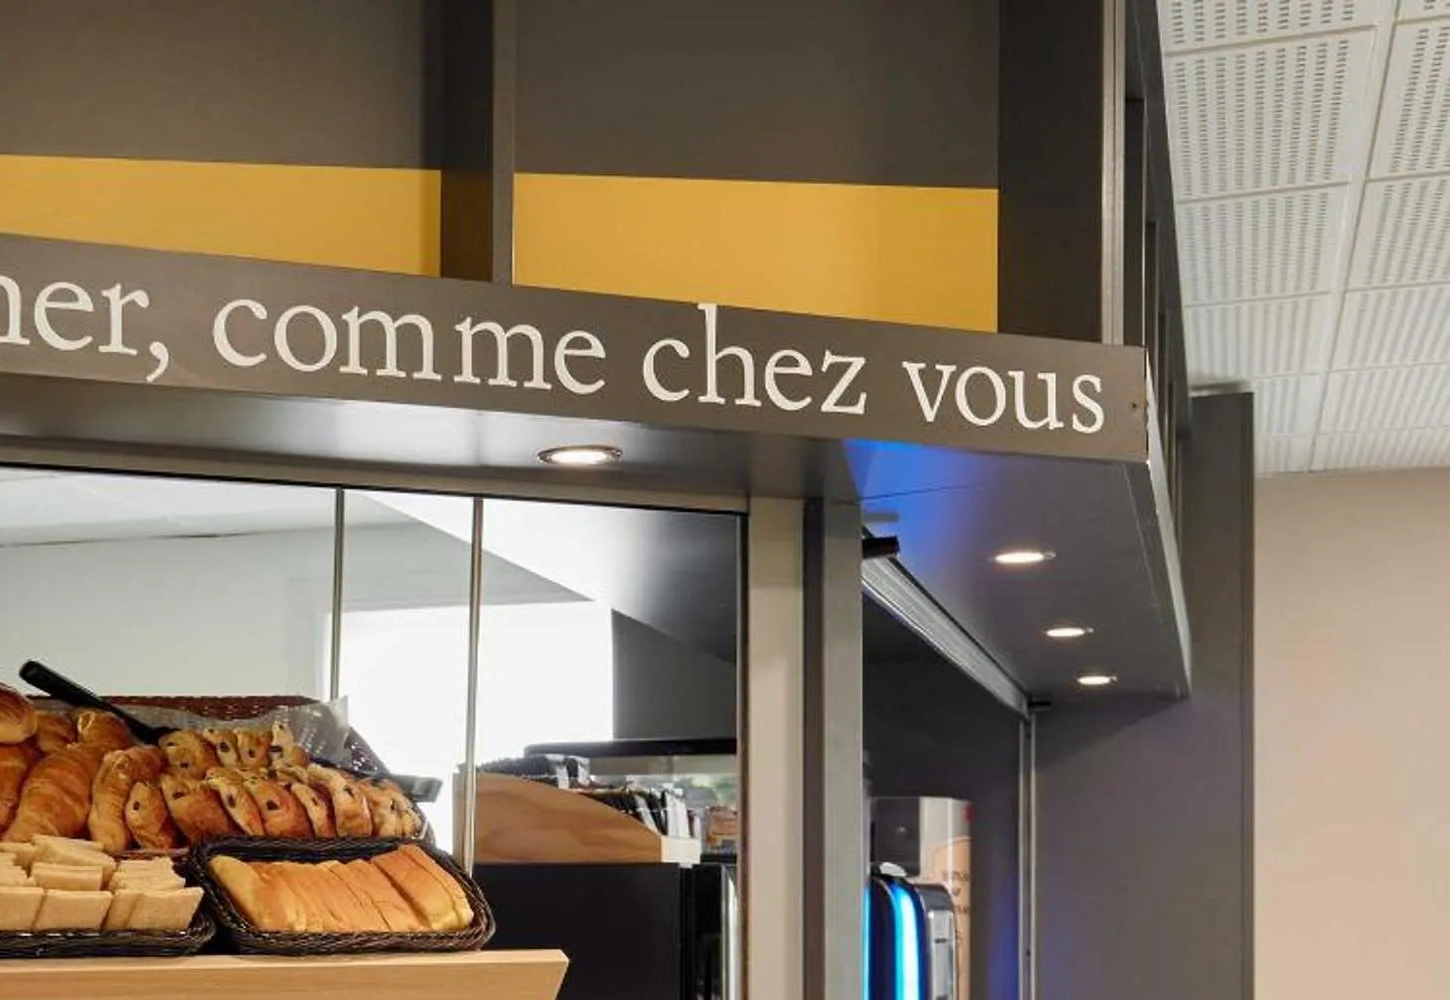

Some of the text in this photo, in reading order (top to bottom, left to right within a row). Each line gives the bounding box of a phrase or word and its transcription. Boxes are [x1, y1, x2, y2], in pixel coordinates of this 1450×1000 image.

[211, 298, 607, 395] comme
[642, 303, 868, 415] chez
[901, 360, 1106, 434] vous
